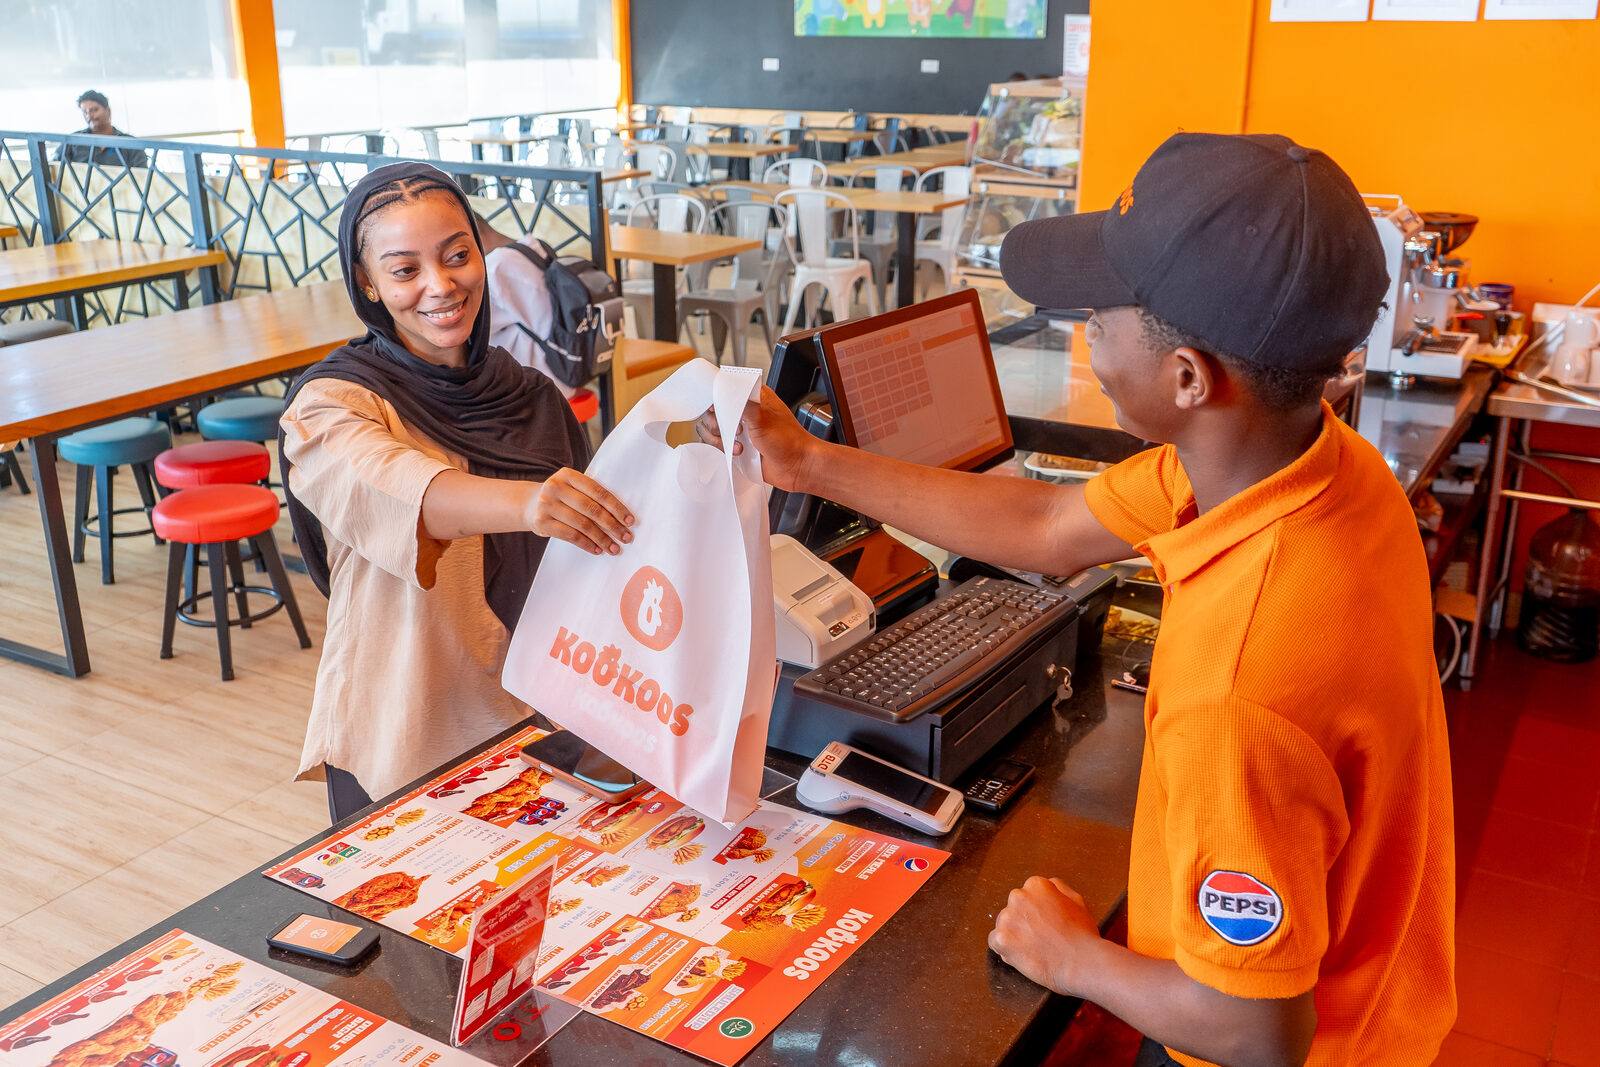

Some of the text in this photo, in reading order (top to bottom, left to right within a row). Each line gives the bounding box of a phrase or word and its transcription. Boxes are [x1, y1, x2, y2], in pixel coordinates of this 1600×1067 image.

[549, 626, 694, 737] KOOKOOS
[818, 754, 836, 770] DTB
[434, 818, 464, 834] SIDES
[414, 834, 437, 846] AND
[880, 844, 900, 858] BOX
[377, 846, 416, 867] DRINKS
[445, 859, 488, 885] CHICKEN
[857, 858, 885, 880] MEALS
[628, 875, 660, 896] STRIPS
[736, 882, 779, 916] BAHATI BOX
[1205, 892, 1277, 917] PEPSI
[423, 909, 443, 921] BOX
[585, 911, 612, 928] POPS
[783, 908, 874, 981] KOOKOOS
[253, 989, 296, 1018] FAMILY
[703, 986, 743, 1018] SAUCED
[196, 1018, 252, 1053] COMBOS
[328, 1020, 373, 1050] DOUBLE
